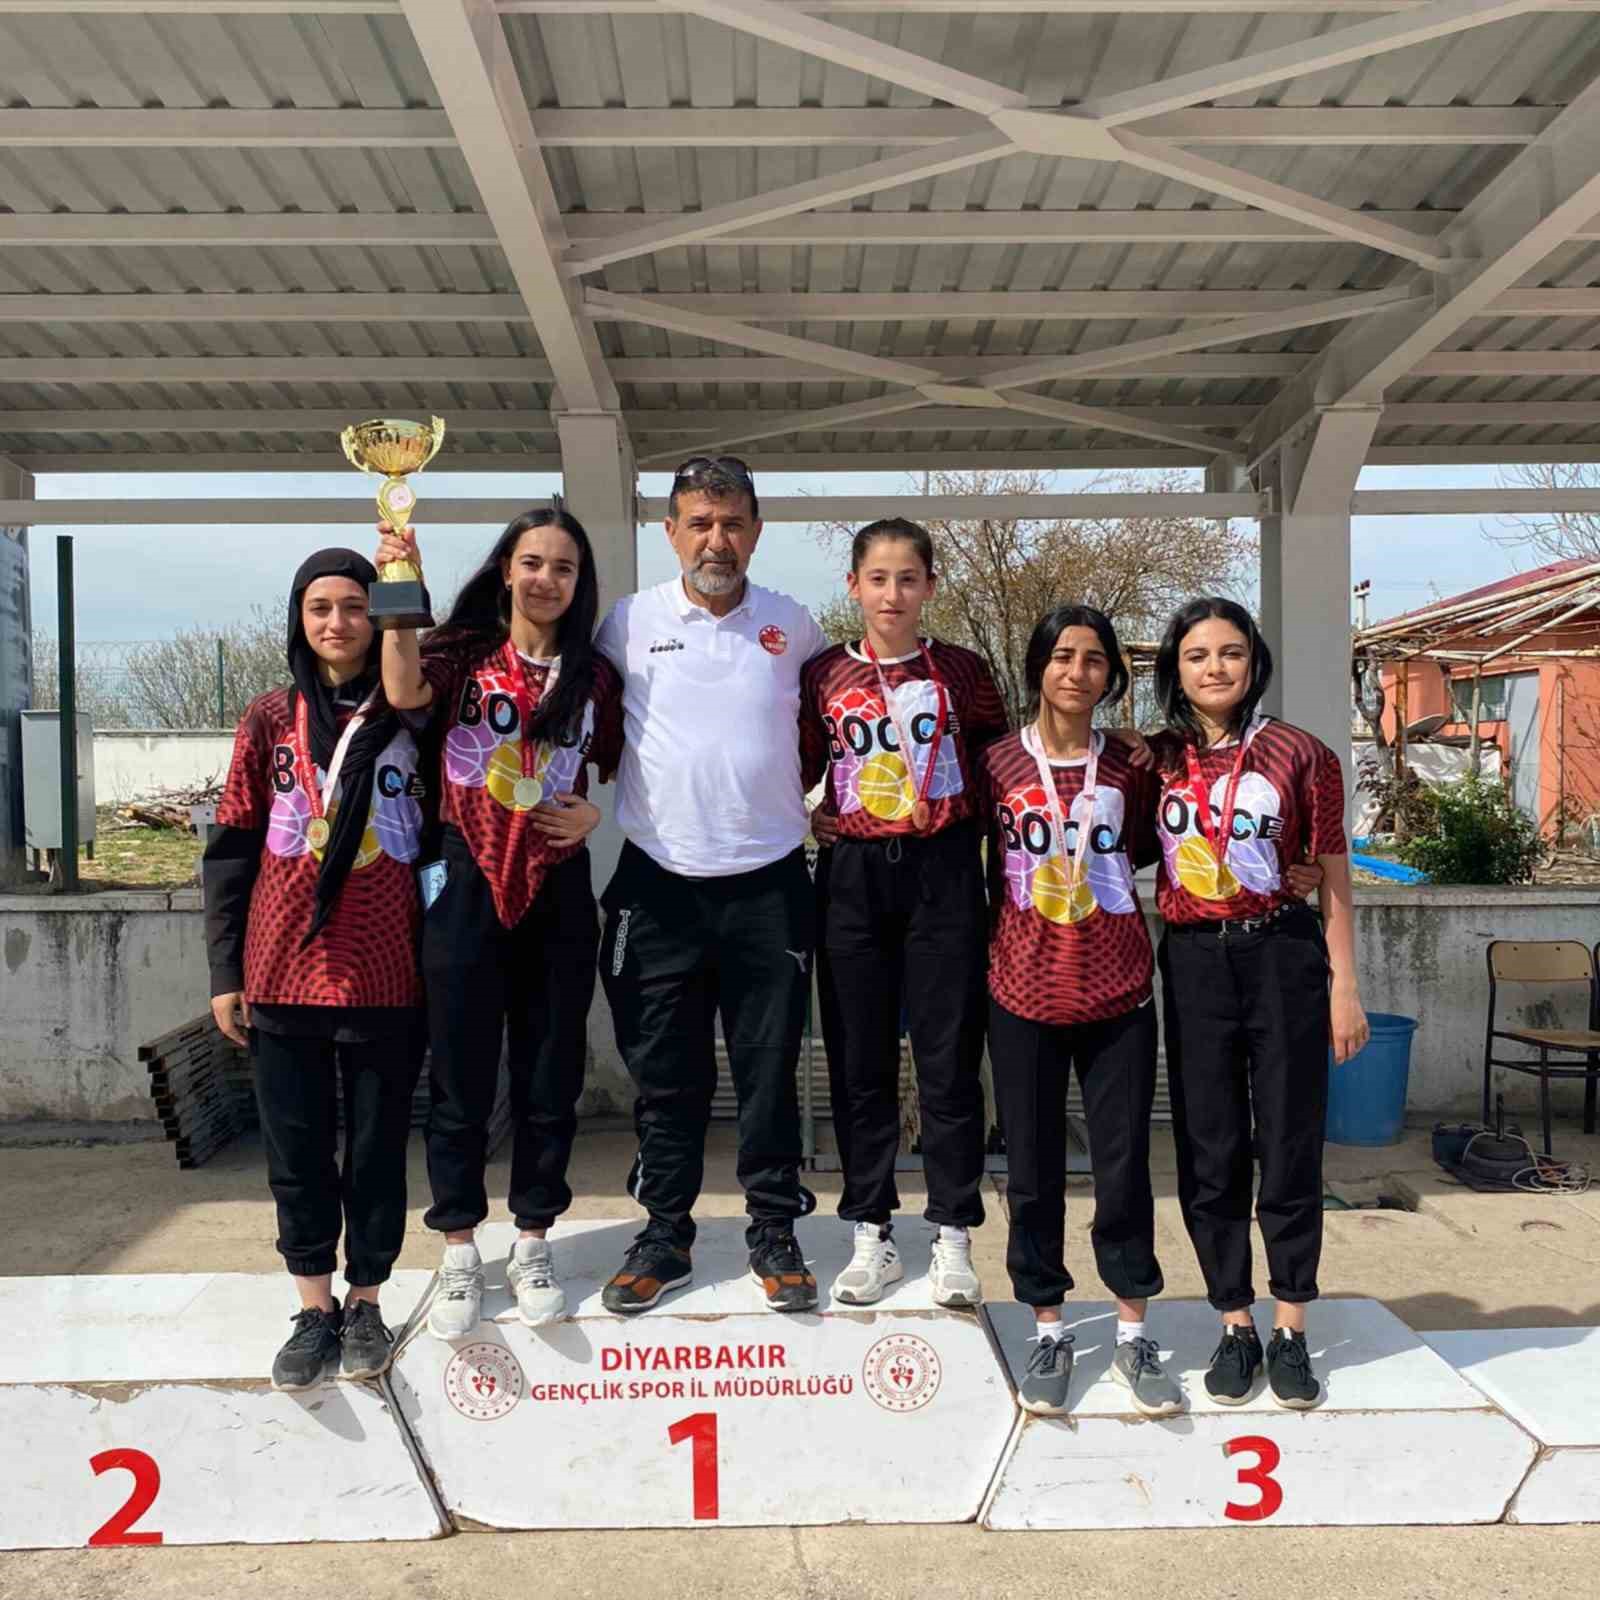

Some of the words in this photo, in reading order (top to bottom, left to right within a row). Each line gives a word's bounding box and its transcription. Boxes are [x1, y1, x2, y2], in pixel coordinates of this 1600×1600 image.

[531, 1379, 624, 1405] GENÇLİK
[628, 1381, 685, 1399] SPOR
[690, 1377, 709, 1398] İL
[714, 1374, 853, 1397] MÜDÜRLÜĞÜ
[601, 1342, 786, 1371] DİYARBAKIR
[88, 1448, 163, 1547] 2
[668, 1412, 720, 1521] 1
[1224, 1435, 1283, 1521] 3
